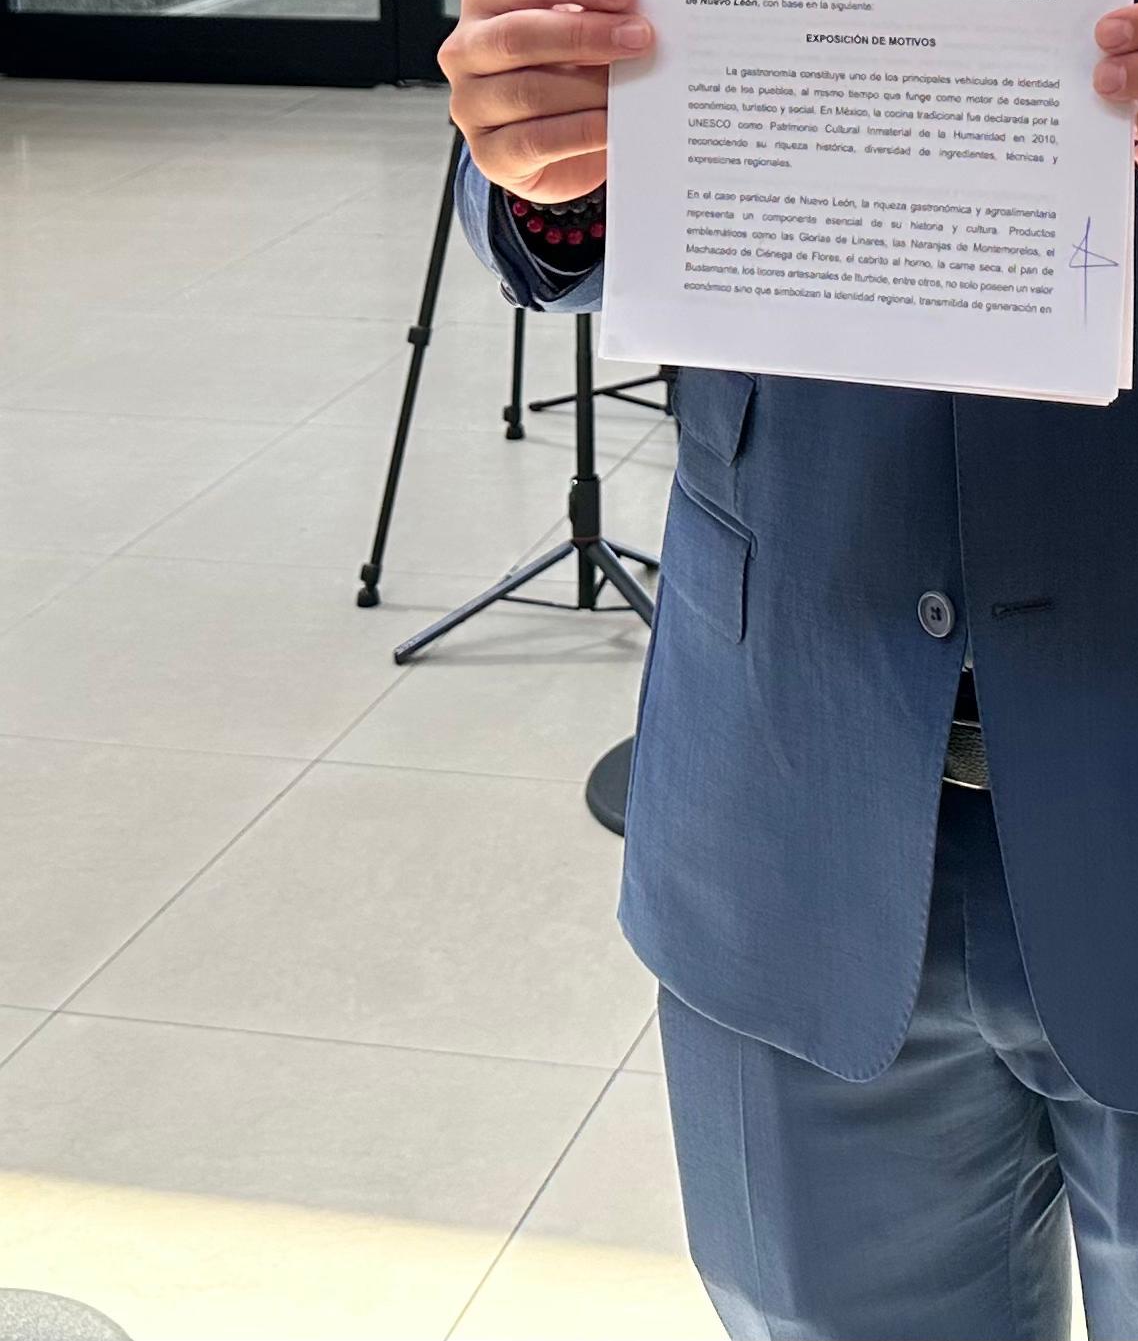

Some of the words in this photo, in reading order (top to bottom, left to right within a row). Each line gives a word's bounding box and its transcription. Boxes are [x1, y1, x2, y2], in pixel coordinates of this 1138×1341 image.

[807, 33, 870, 44] EXPOSICIÓN
[872, 36, 887, 45] DE
[889, 37, 937, 47] MOTIVOS
